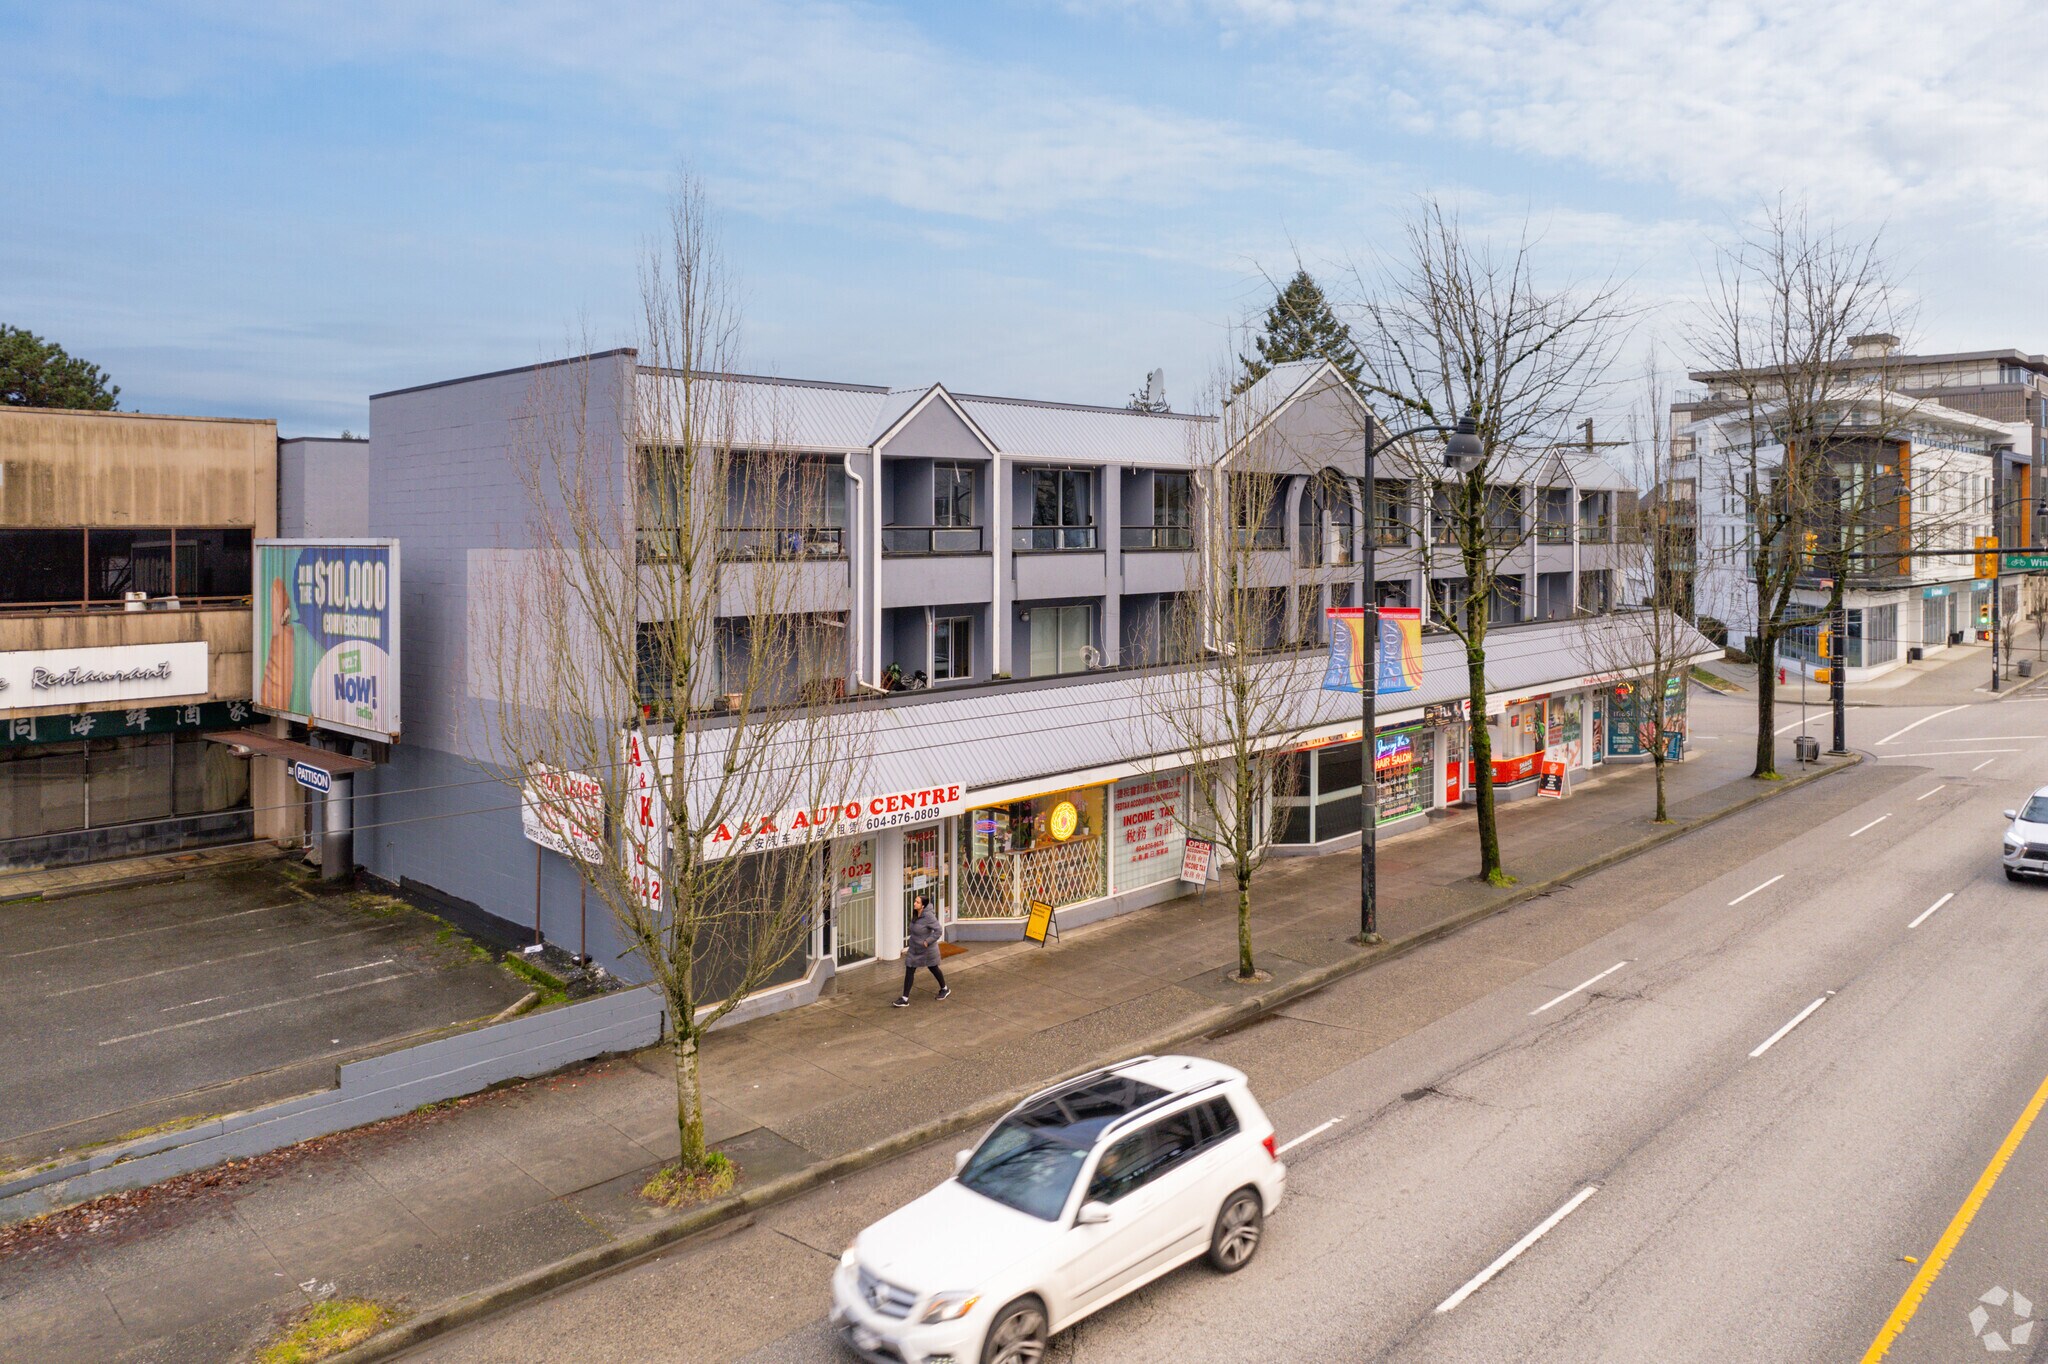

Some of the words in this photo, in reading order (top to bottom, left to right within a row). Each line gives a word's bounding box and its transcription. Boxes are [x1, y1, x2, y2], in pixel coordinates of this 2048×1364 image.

[314, 557, 387, 611] $10,000
[322, 612, 381, 641] CONVERSATION
[32, 660, 172, 690] Restaurant
[334, 673, 377, 709] NOW!
[1376, 757, 1390, 769] HAIR
[1391, 752, 1412, 765] SALON
[297, 766, 328, 788] PATTISON
[629, 737, 642, 767] A
[640, 795, 654, 828] K
[712, 823, 732, 843] A
[792, 801, 861, 830] AUTO
[869, 785, 960, 815] CENTRE
[866, 807, 940, 830] 604-876-0809
[1123, 809, 1155, 827] INCOME
[1159, 804, 1175, 818] TAX
[1188, 840, 1210, 850] OPEN
[841, 862, 872, 878] 1022
